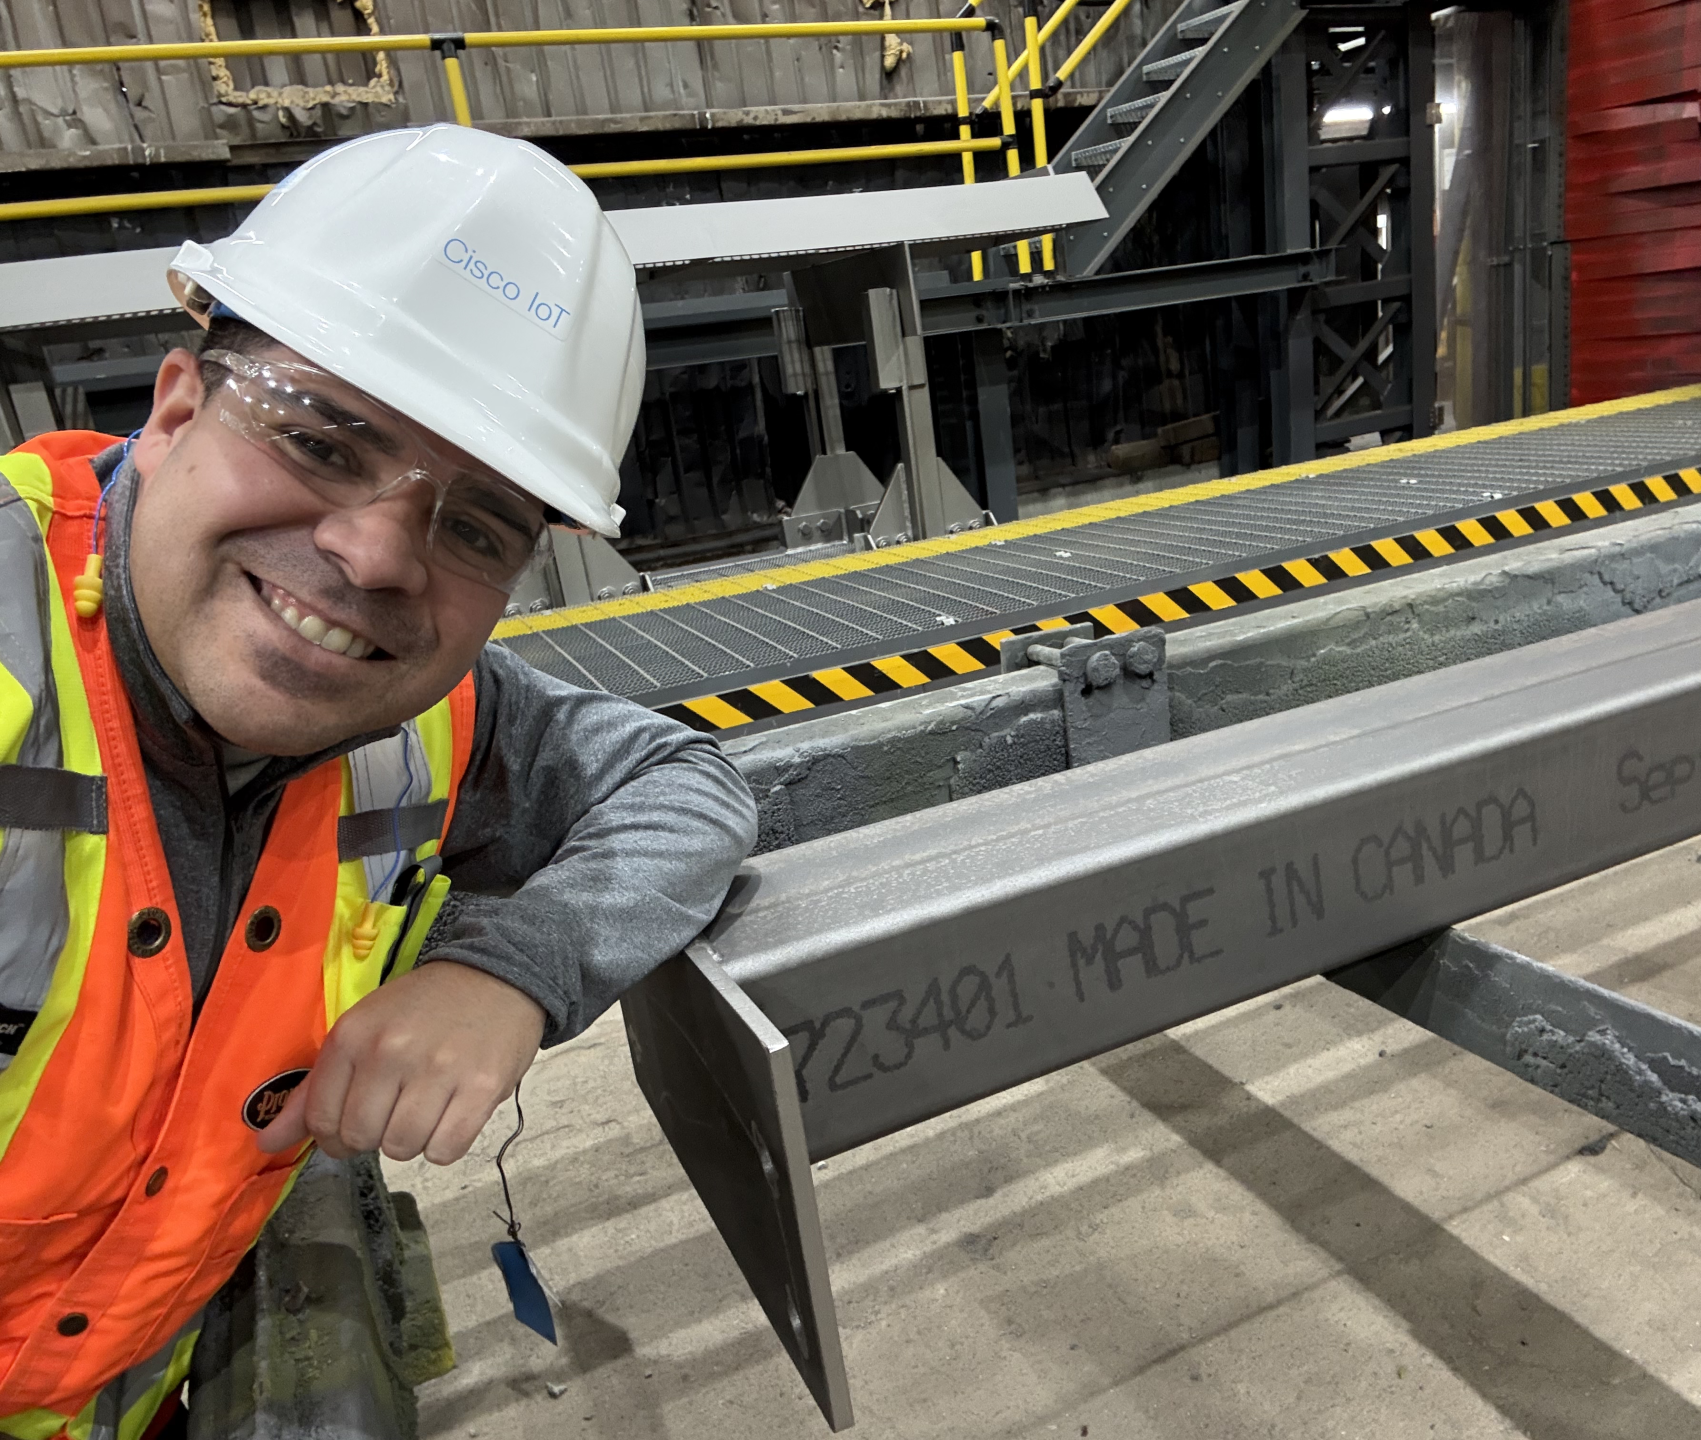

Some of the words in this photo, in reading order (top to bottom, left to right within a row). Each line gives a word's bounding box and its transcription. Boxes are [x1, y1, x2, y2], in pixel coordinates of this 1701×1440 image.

[443, 238, 521, 301] Cisco
[527, 291, 571, 329] IoT
[1066, 887, 1225, 1003] MADE
[1258, 852, 1326, 938] IN
[1351, 787, 1539, 902] CANADA
